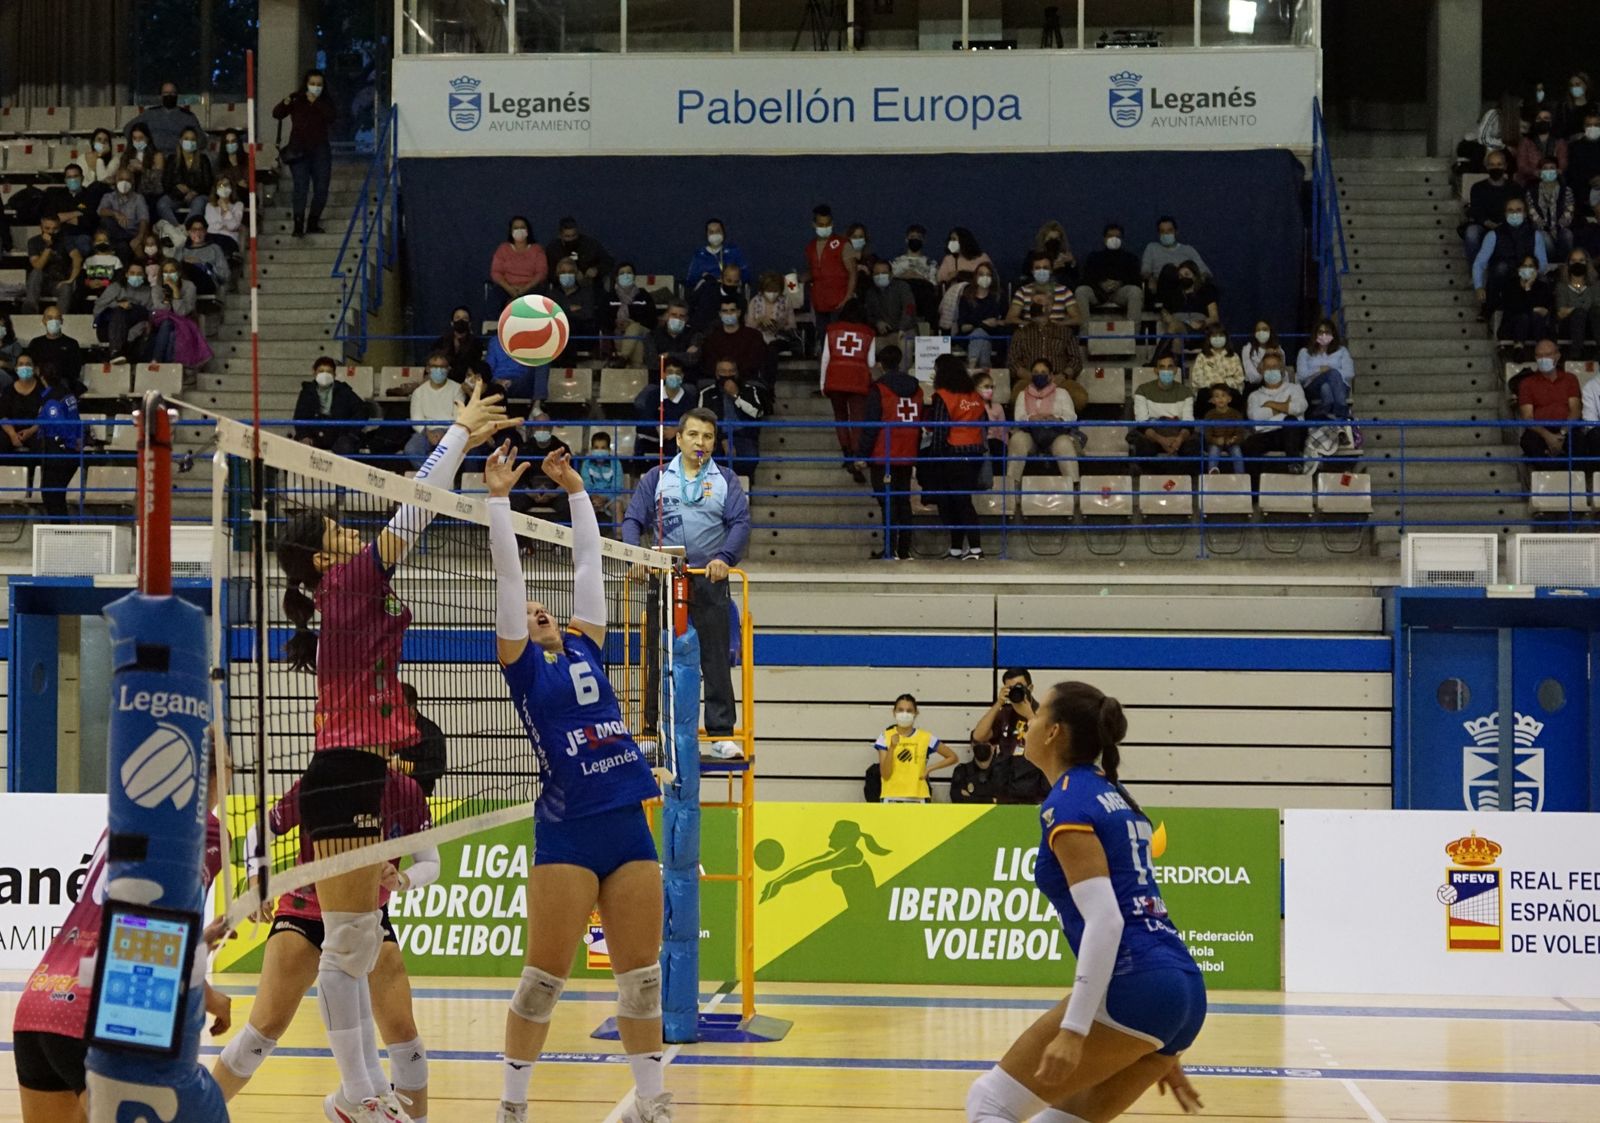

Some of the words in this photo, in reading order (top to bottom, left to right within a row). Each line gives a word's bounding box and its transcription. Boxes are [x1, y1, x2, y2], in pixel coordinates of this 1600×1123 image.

[489, 91, 590, 118] Leganés
[678, 88, 854, 124] Pabellón
[873, 87, 1022, 130] Europa
[1151, 86, 1257, 113] Leganés
[489, 119, 590, 131] AYUNTAMIENTO
[1151, 115, 1257, 128] AYUNTAMIENTO
[569, 661, 600, 706] 6
[581, 749, 638, 776] Leganés
[459, 845, 528, 878] LIGA
[993, 847, 1040, 881] LIG
[1153, 866, 1251, 884] ERDROLA
[1453, 873, 1495, 884] RFEVB
[1510, 871, 1562, 890] REAL
[388, 885, 528, 918] ERDROLA
[924, 928, 1062, 960] VOLEIBOL
[1189, 930, 1254, 941] Federación
[1511, 934, 1537, 953] DE
